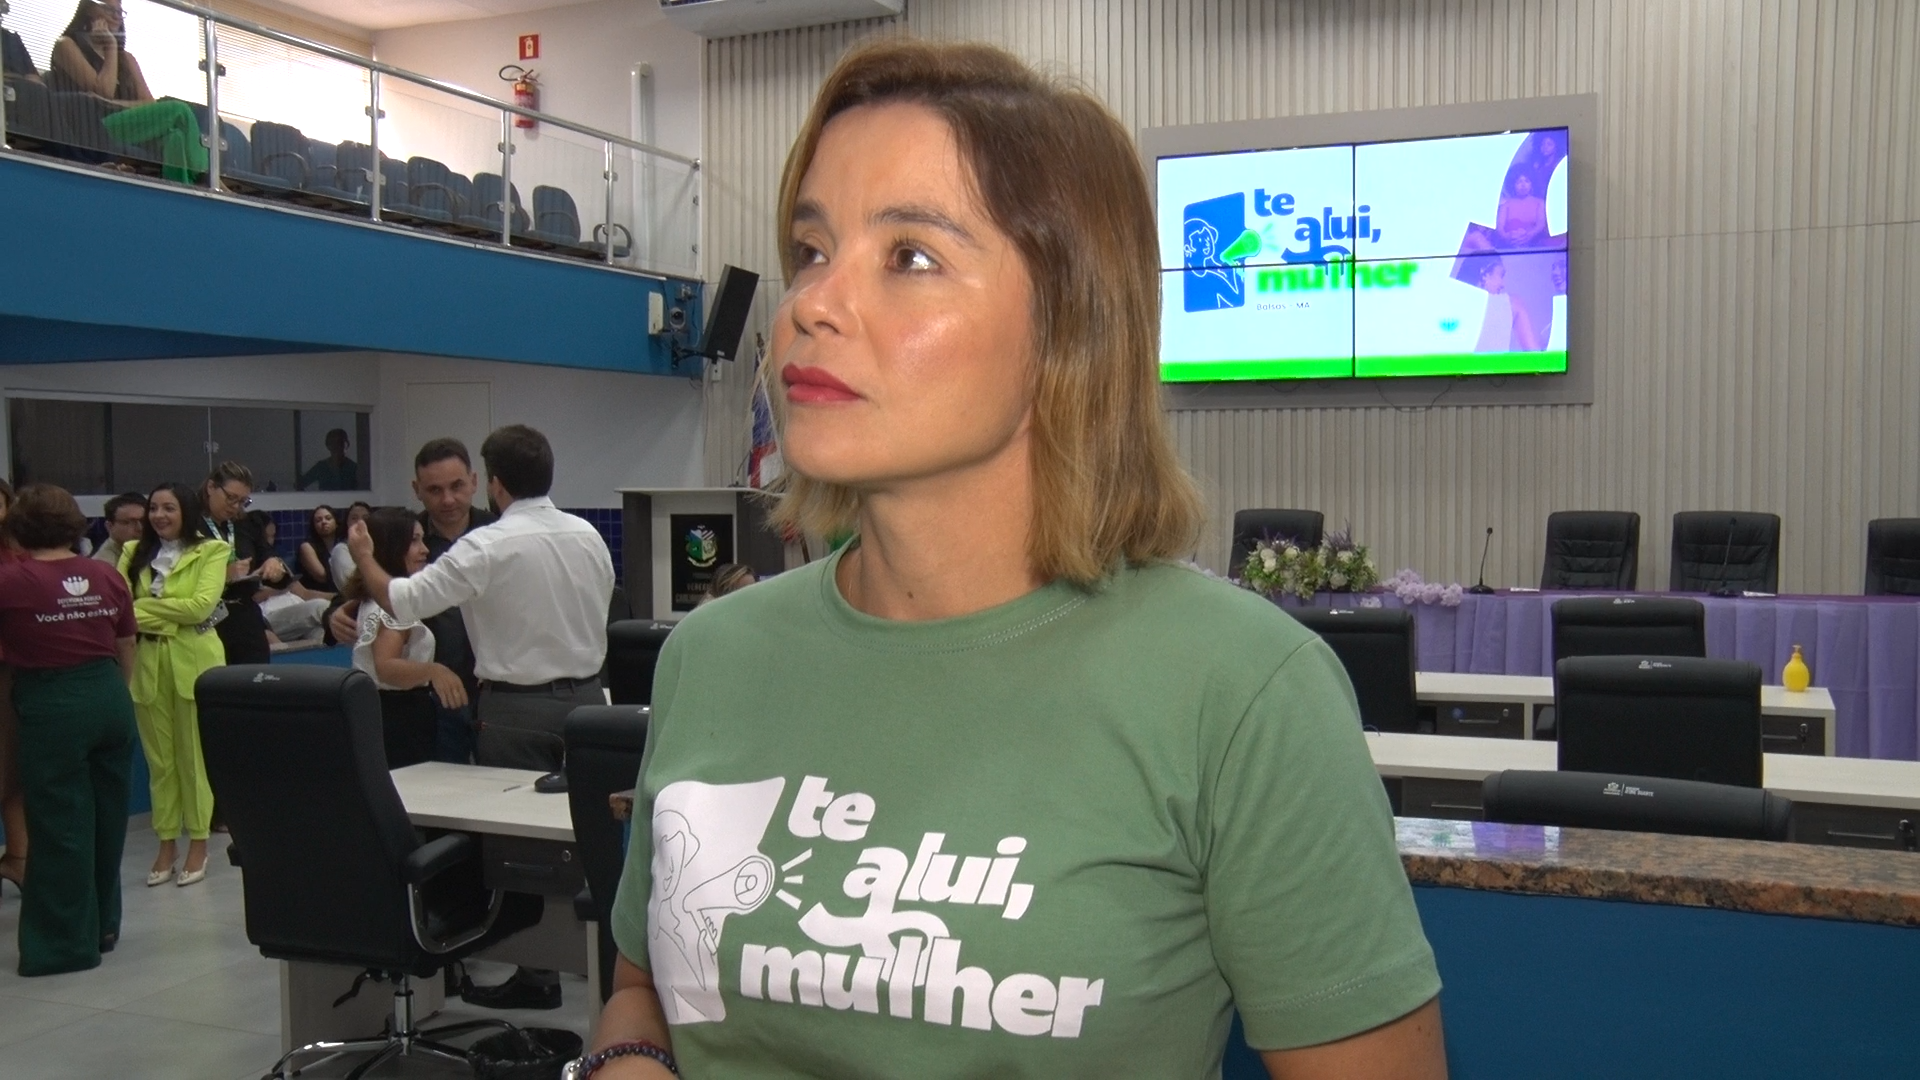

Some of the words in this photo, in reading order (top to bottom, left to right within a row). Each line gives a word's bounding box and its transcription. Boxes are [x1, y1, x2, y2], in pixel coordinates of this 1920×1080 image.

[1254, 188, 1295, 217] te
[1283, 205, 1382, 258] alui,
[1257, 255, 1418, 292] mulher
[36, 612, 65, 622] Você
[66, 610, 86, 620] não
[788, 775, 876, 841] te
[818, 832, 1035, 938] alui,
[740, 935, 1105, 1039] mulher
